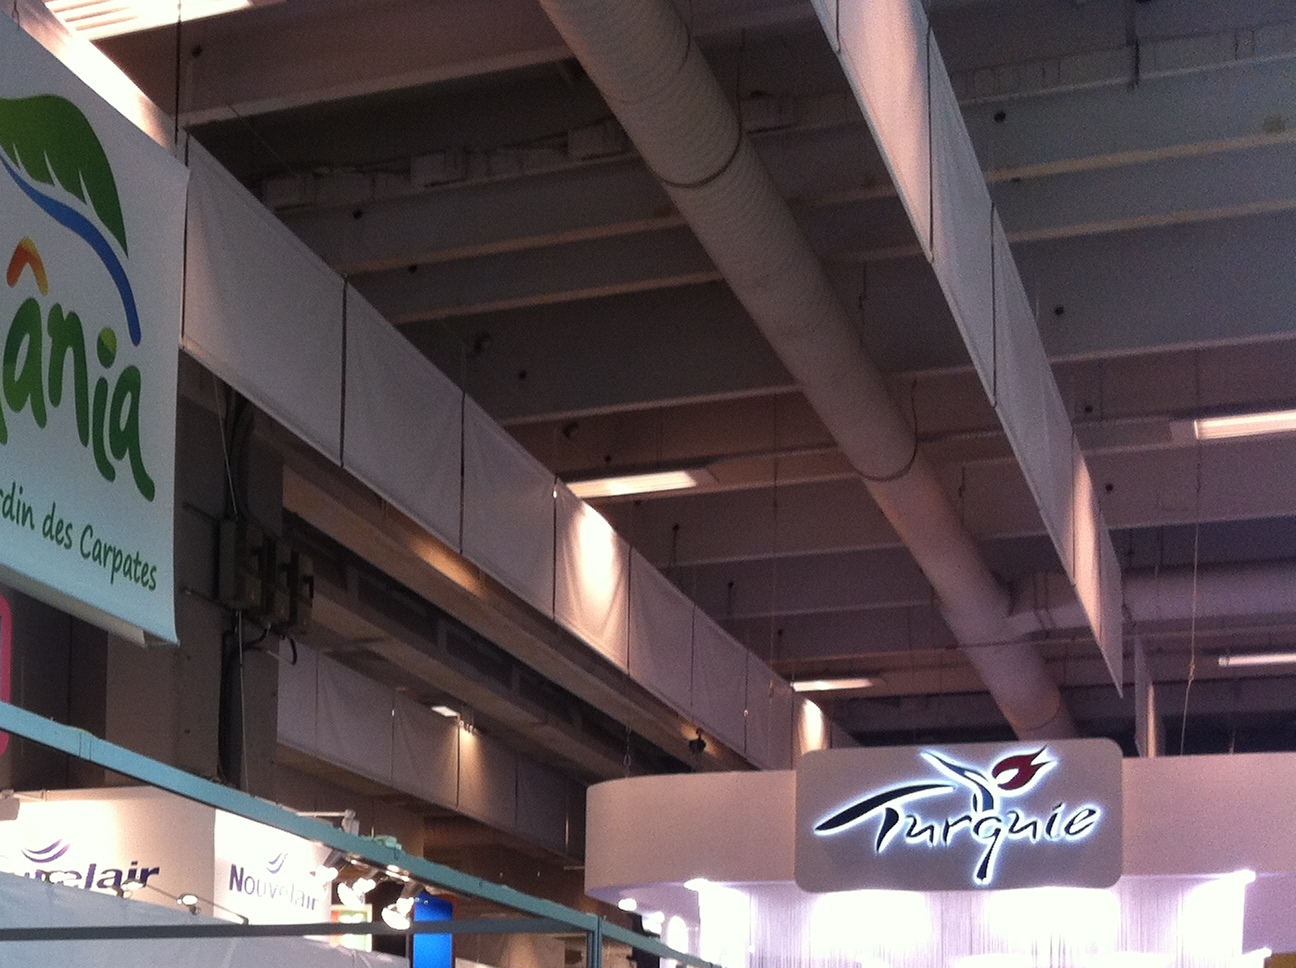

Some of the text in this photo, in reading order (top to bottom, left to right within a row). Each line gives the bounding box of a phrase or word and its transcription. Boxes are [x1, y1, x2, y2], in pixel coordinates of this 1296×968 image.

[42, 501, 73, 549] des
[80, 524, 157, 591] Carpates
[814, 782, 1102, 884] Turquie
